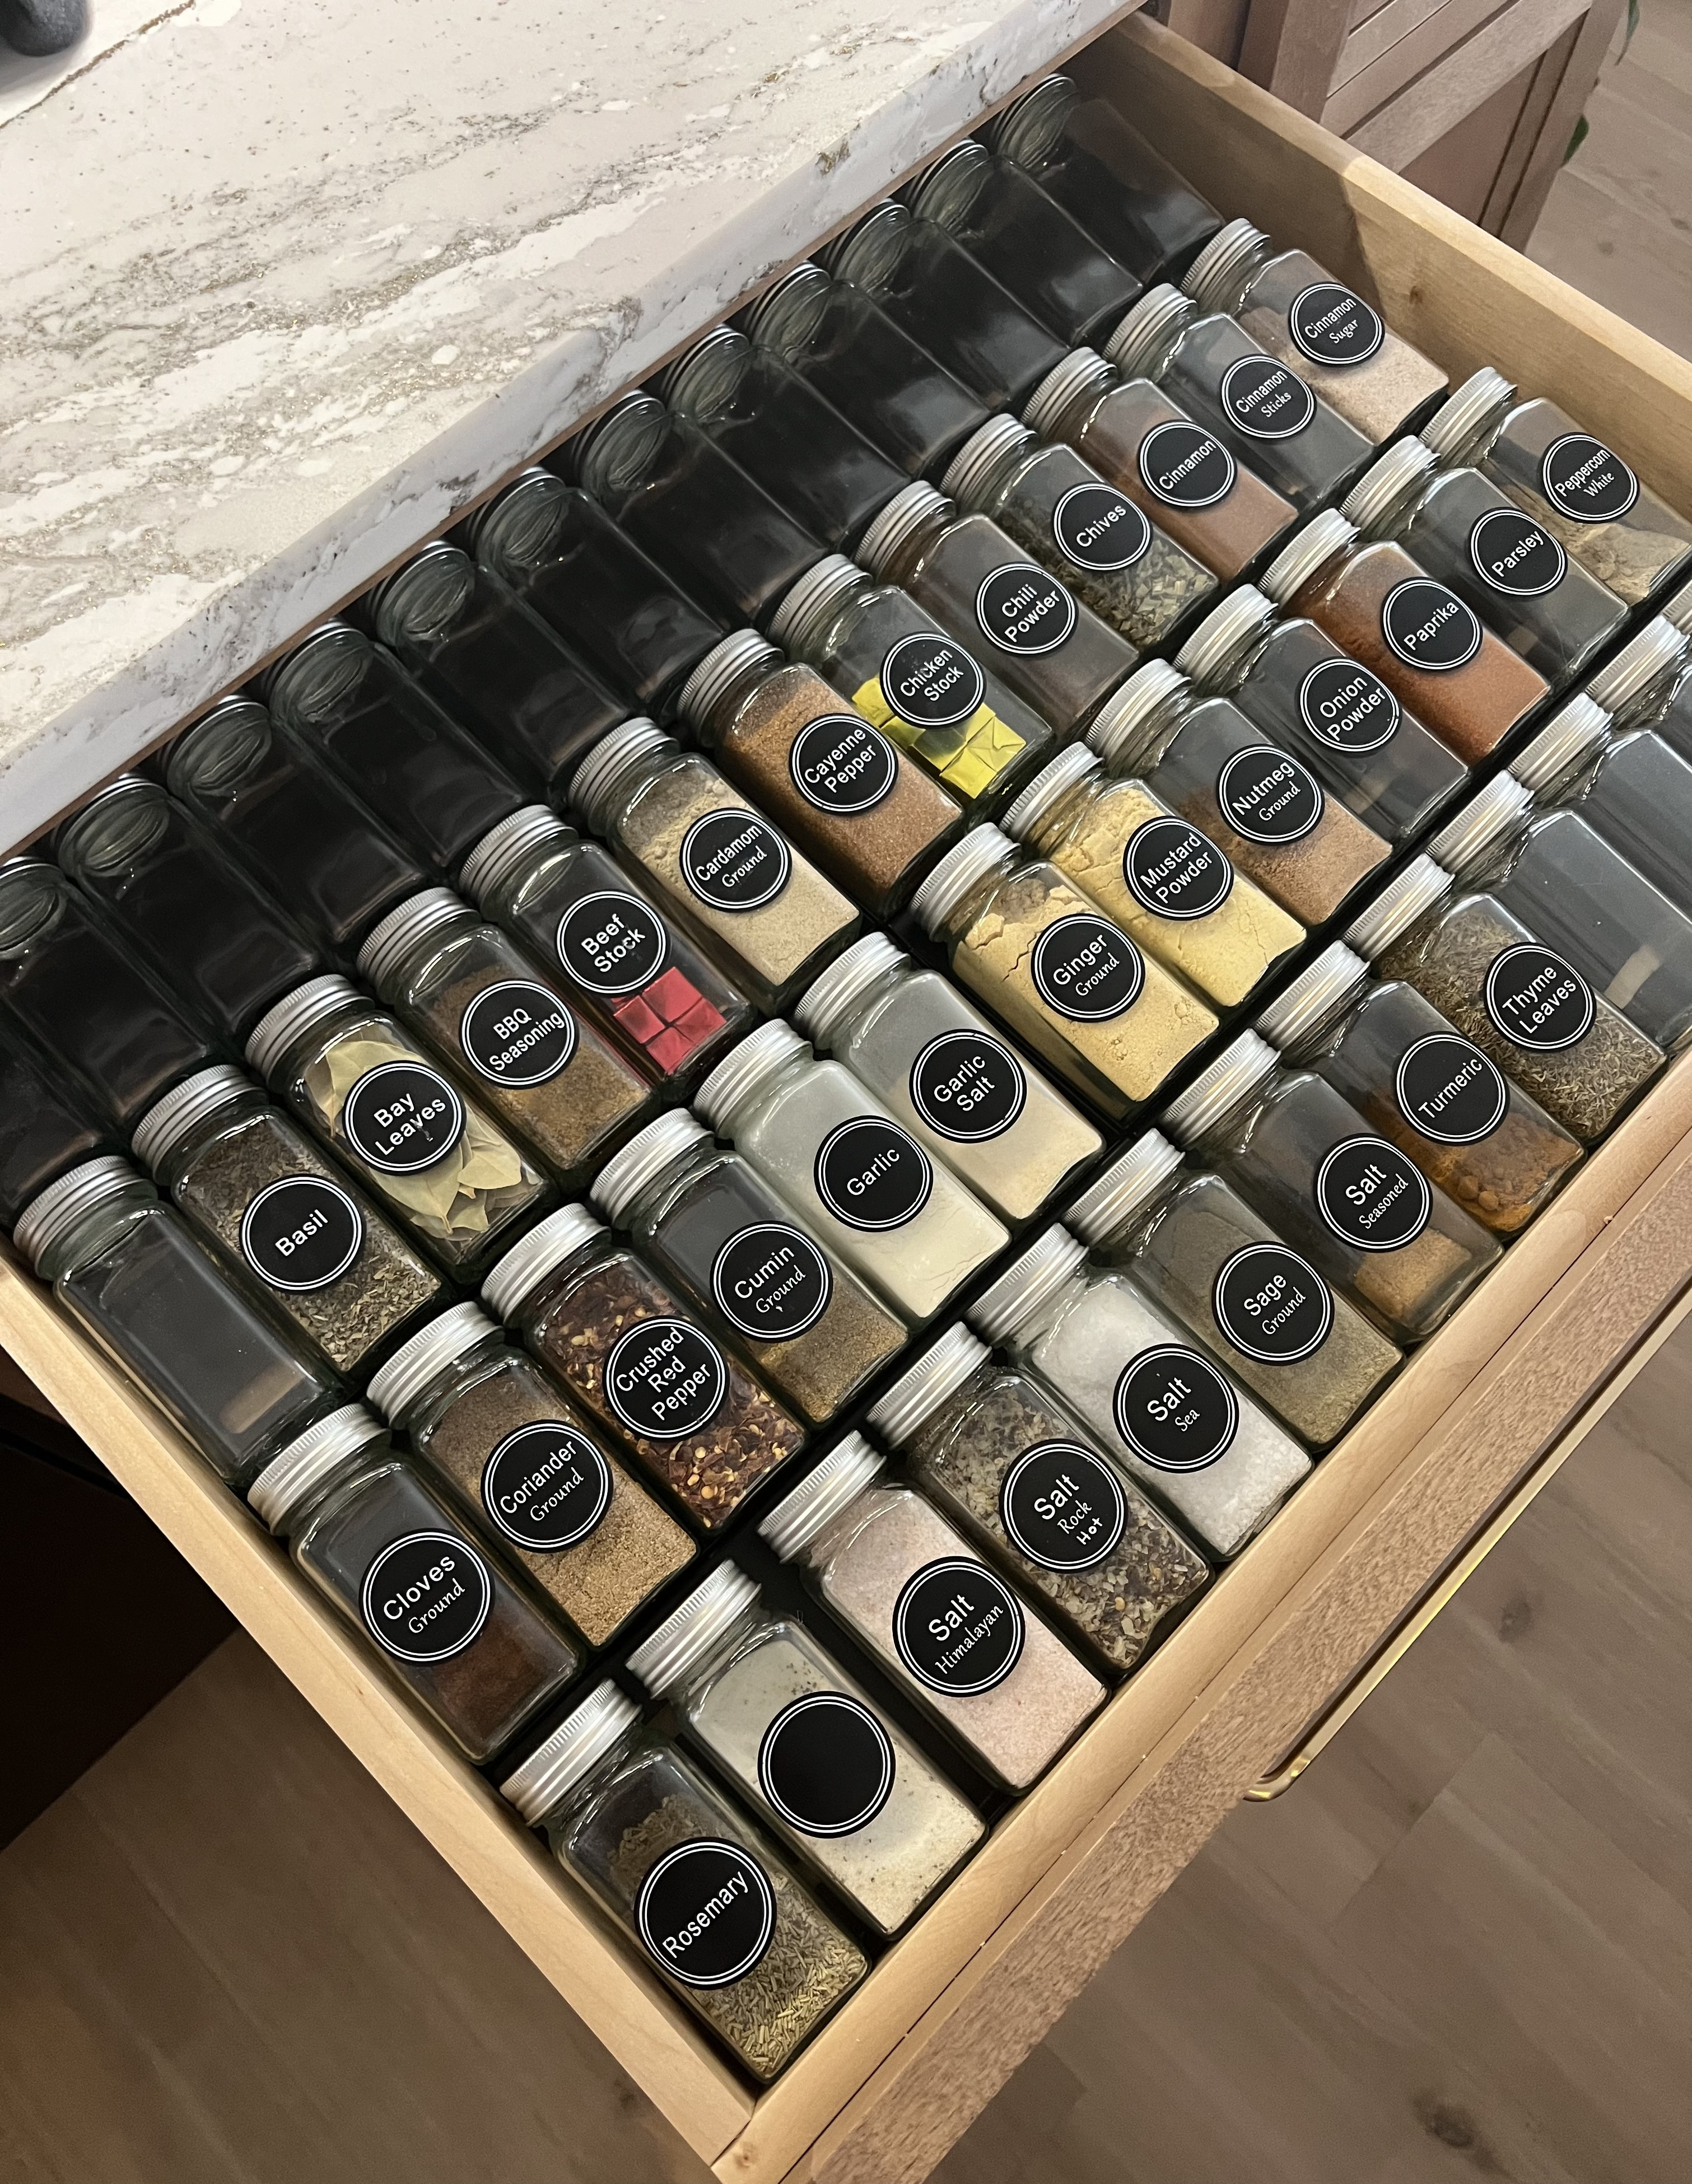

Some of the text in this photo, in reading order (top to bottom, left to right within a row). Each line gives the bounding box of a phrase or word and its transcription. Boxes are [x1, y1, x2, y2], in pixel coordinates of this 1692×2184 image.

[1304, 298, 1357, 339] Cinnamon
[1329, 319, 1358, 344] Sugar
[1236, 371, 1288, 413] Cinnamon
[1261, 391, 1292, 417] Sticks
[1159, 440, 1217, 490] Cinnamon
[1554, 449, 1611, 497] Peppercorn
[1583, 472, 1615, 497] White
[1076, 505, 1126, 547] Chives
[1491, 531, 1544, 577] Parsley
[1001, 584, 1038, 618] Chili
[1004, 590, 1061, 643] Powder
[1403, 602, 1460, 650] Paprika
[900, 649, 953, 697] Chicken
[924, 665, 964, 702] Stock
[1320, 675, 1368, 719] Onion
[1327, 687, 1386, 741] Powder
[804, 728, 867, 784] Cayenne
[824, 744, 876, 793] Pepper
[1231, 762, 1295, 815] Nutmeg
[1258, 781, 1301, 821] Ground
[695, 824, 763, 881] Cardamom
[721, 846, 767, 888] Ground
[1140, 833, 1201, 889] Mustard
[1155, 851, 1213, 904] Powder
[581, 913, 626, 955] Beef
[593, 928, 646, 973] Stock
[1052, 934, 1107, 986] Ginger
[1075, 953, 1120, 996] Ground
[1502, 967, 1557, 1016] Thyme
[1519, 979, 1576, 1034] Leaves
[488, 1011, 565, 1071] Seasoning
[493, 1008, 533, 1040] BBQ
[933, 1053, 985, 1103] Garlic
[957, 1077, 995, 1112] Salt
[1418, 1058, 1483, 1119] Turmeric
[374, 1092, 414, 1127] Bay
[375, 1097, 446, 1155] Leaves
[846, 1147, 901, 1196] Garlic
[1345, 1164, 1387, 1206] Salt
[1359, 1174, 1409, 1230] Seasoned
[275, 1209, 328, 1257] Basil
[734, 1244, 795, 1300] Cumin
[755, 1264, 807, 1313] Ground
[1243, 1273, 1287, 1317] Sage
[1261, 1286, 1306, 1335] Ground
[616, 1327, 684, 1393] Crushed
[647, 1356, 686, 1393] Red
[651, 1363, 711, 1421] Pepper
[1146, 1377, 1191, 1422] Salt
[1174, 1409, 1200, 1432] Sea
[500, 1439, 577, 1514] Coriander
[529, 1467, 585, 1522] Ground
[1033, 1474, 1080, 1520] Salt
[1057, 1500, 1093, 1534] Rock
[383, 1554, 455, 1621] Cloves
[408, 1578, 465, 1634] Ground
[928, 1594, 975, 1641] Salt
[935, 1604, 1004, 1674] Himalayan
[662, 1870, 749, 1959] Rosemary
